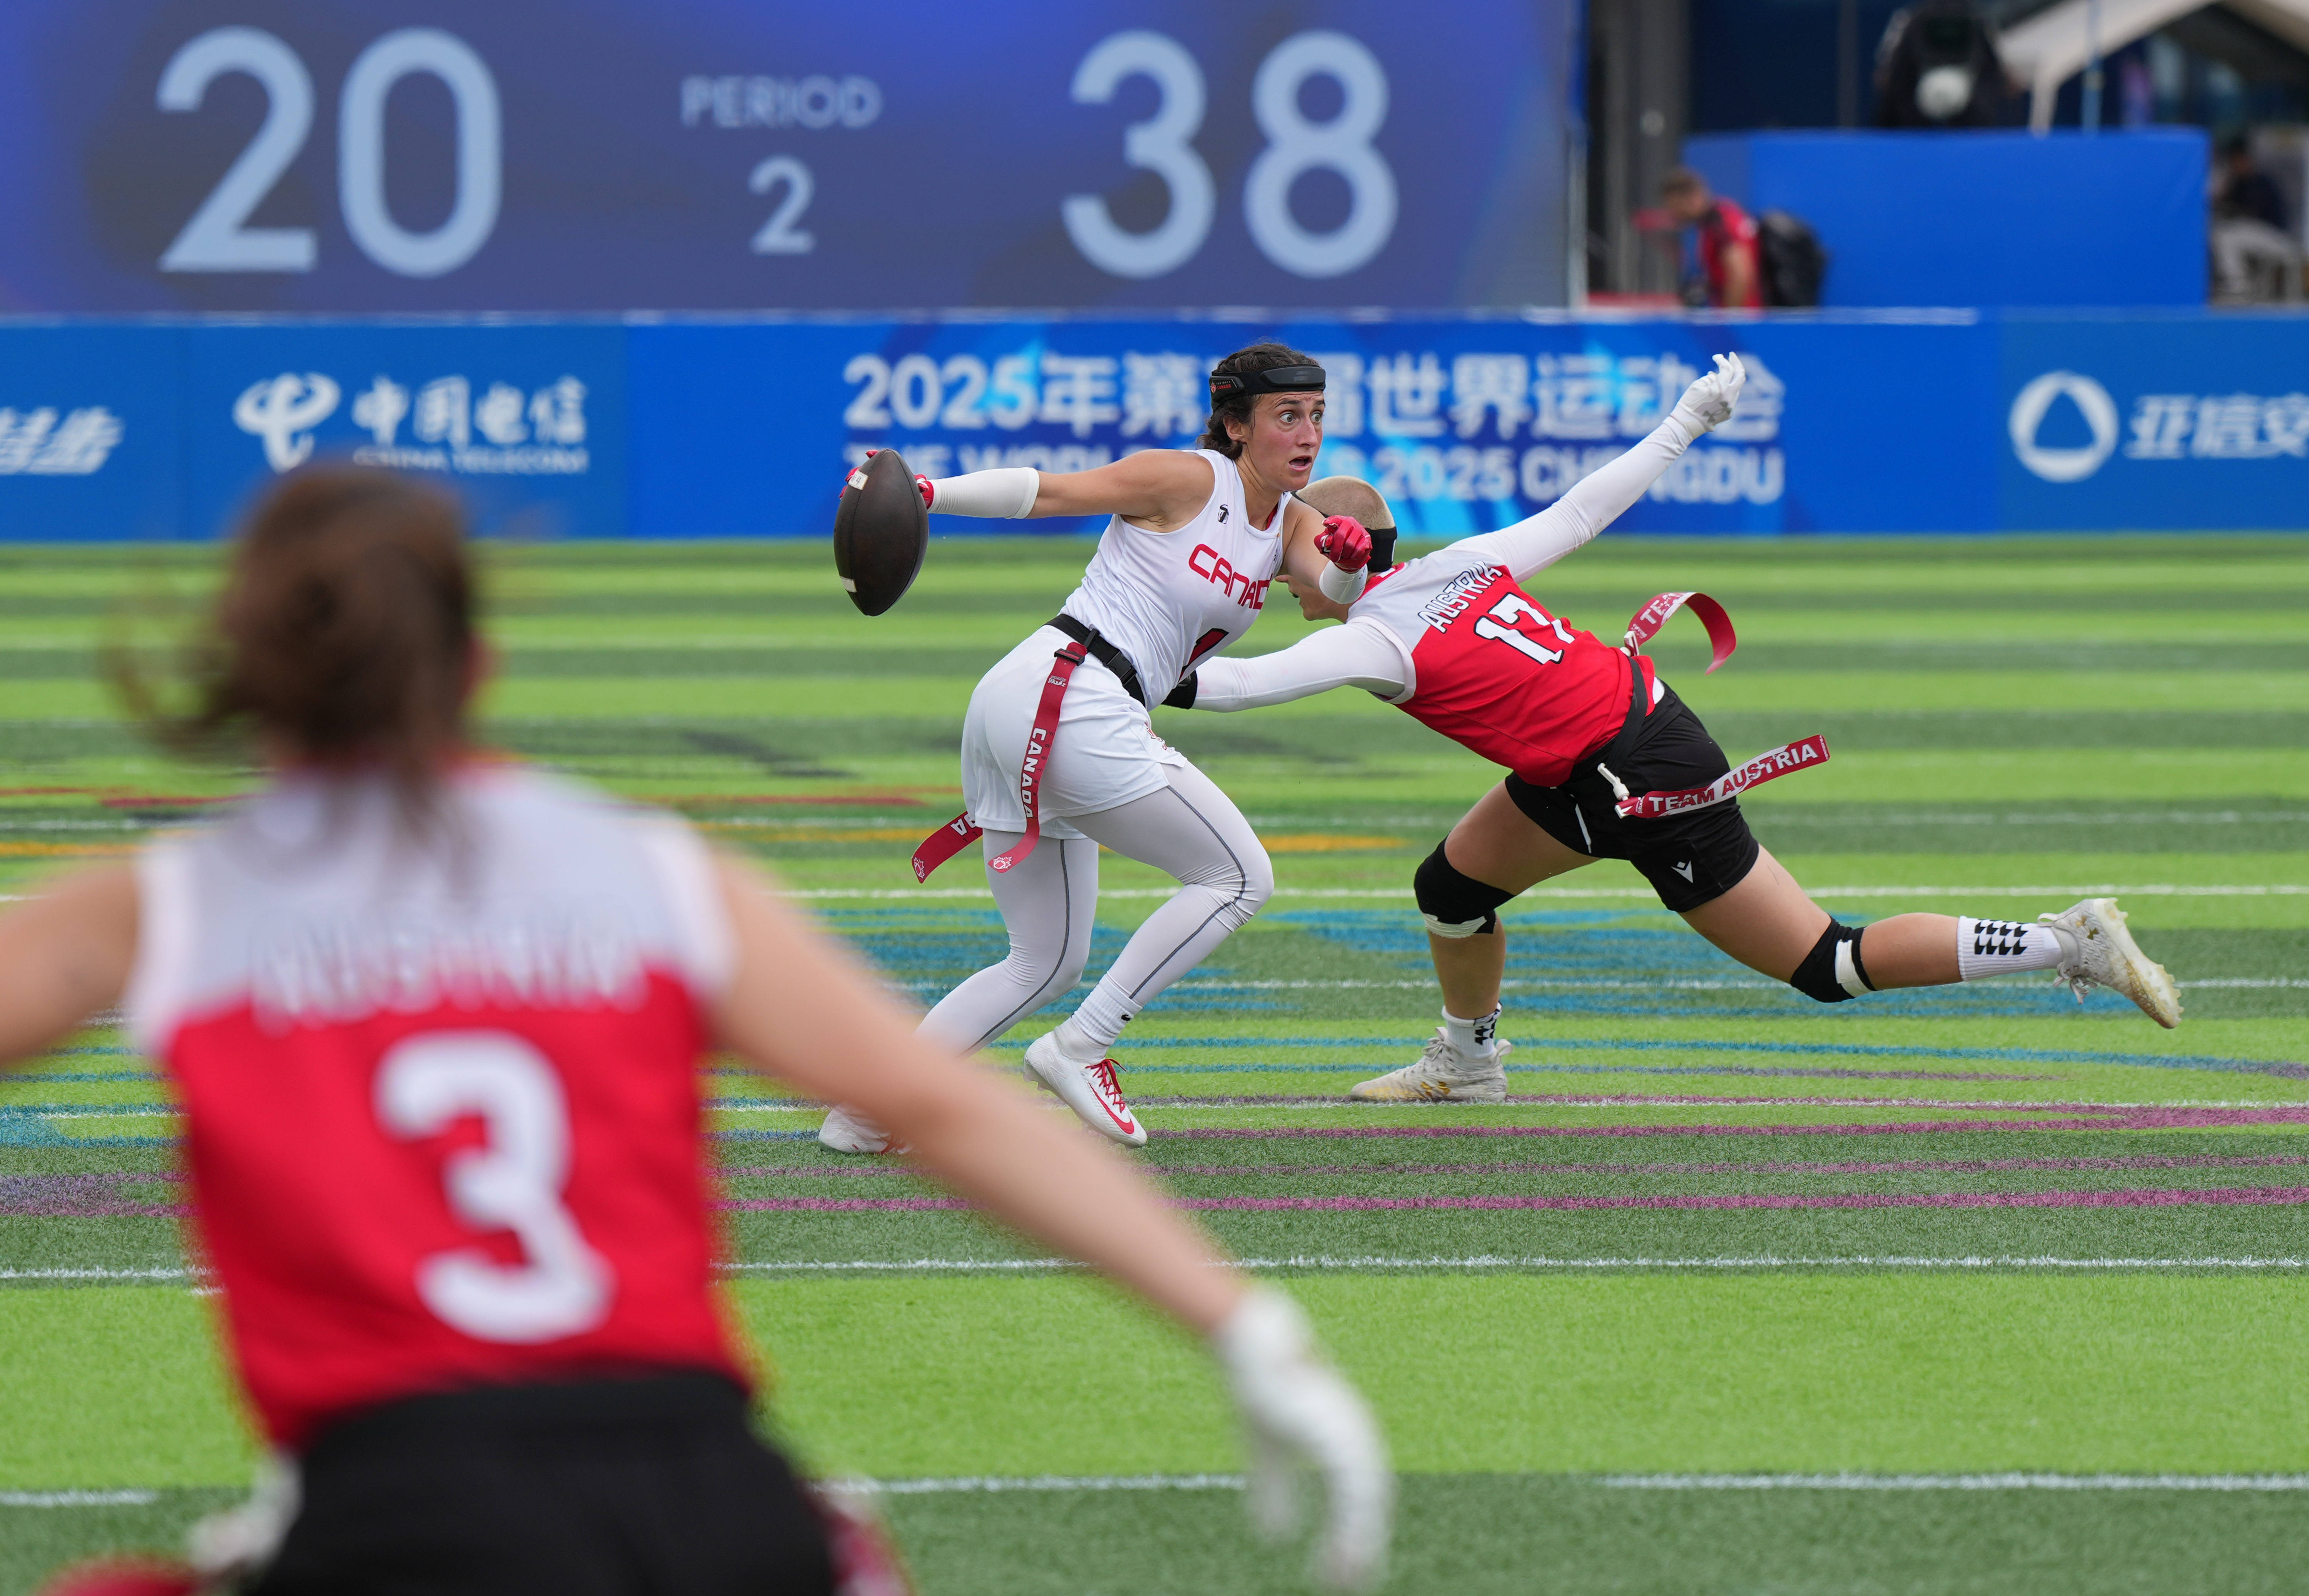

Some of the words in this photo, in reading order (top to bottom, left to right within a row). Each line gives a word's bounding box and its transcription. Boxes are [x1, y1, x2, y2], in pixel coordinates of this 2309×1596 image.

[680, 75, 882, 128] PERIOD
[156, 26, 502, 277] 20
[1061, 29, 1398, 279] 38
[750, 156, 814, 254] 2
[1372, 445, 1517, 501] 2025
[1189, 543, 1273, 610] CANAD
[1418, 561, 1503, 634] AUSTRIA
[1474, 591, 1577, 666] 17
[1022, 727, 1047, 818] CANADA
[1649, 787, 1716, 812] TEAM
[1722, 744, 1819, 797] AUSTRIA
[373, 1028, 616, 1345] 3
